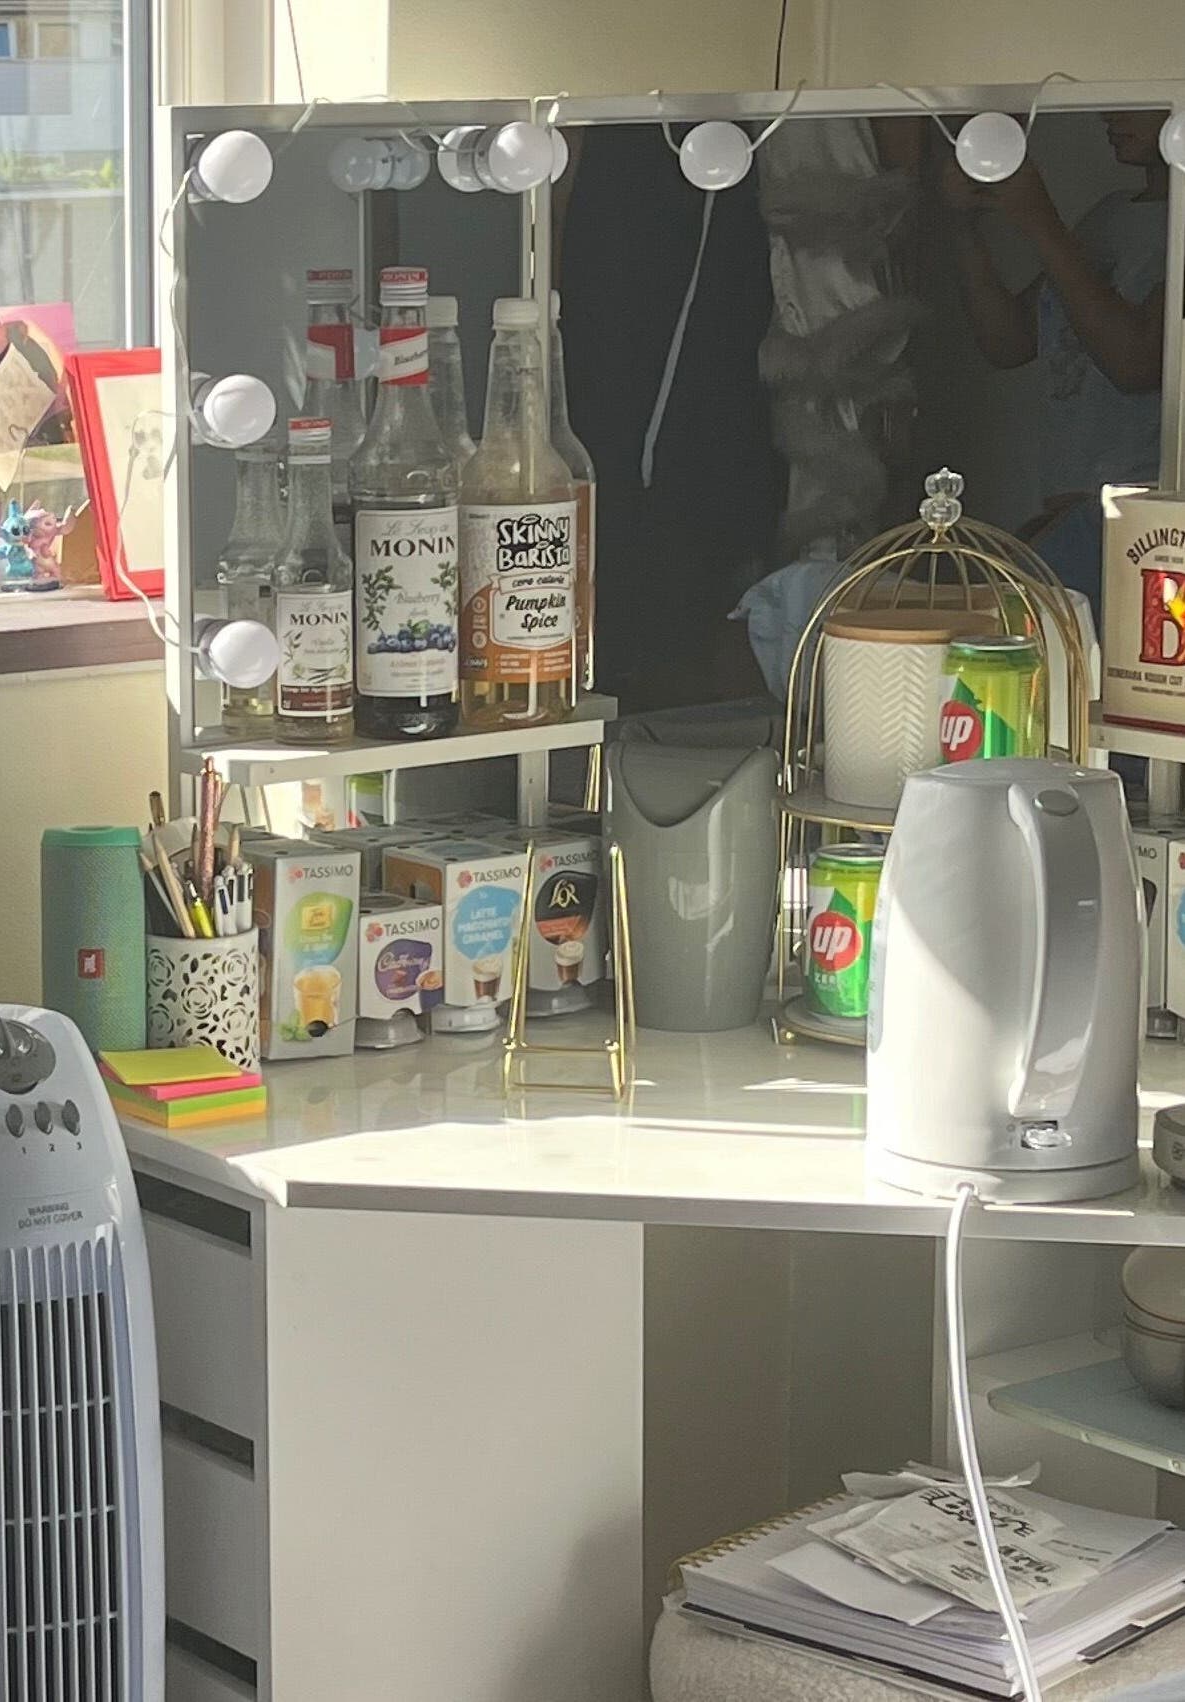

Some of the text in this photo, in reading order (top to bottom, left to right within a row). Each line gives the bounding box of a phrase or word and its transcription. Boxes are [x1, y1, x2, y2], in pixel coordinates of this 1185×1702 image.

[370, 536, 455, 557] MONIN
[505, 592, 566, 613] Pumpkin
[289, 611, 348, 626] MONIN
[520, 612, 559, 632] Spice
[940, 715, 974, 751] up
[302, 864, 354, 879] TASSIMO
[473, 866, 522, 883] TASSIMO
[383, 917, 440, 936] TASSIMO
[813, 926, 853, 960] up
[49, 1143, 55, 1152] 2
[18, 1210, 84, 1230] DO NOT COVER
